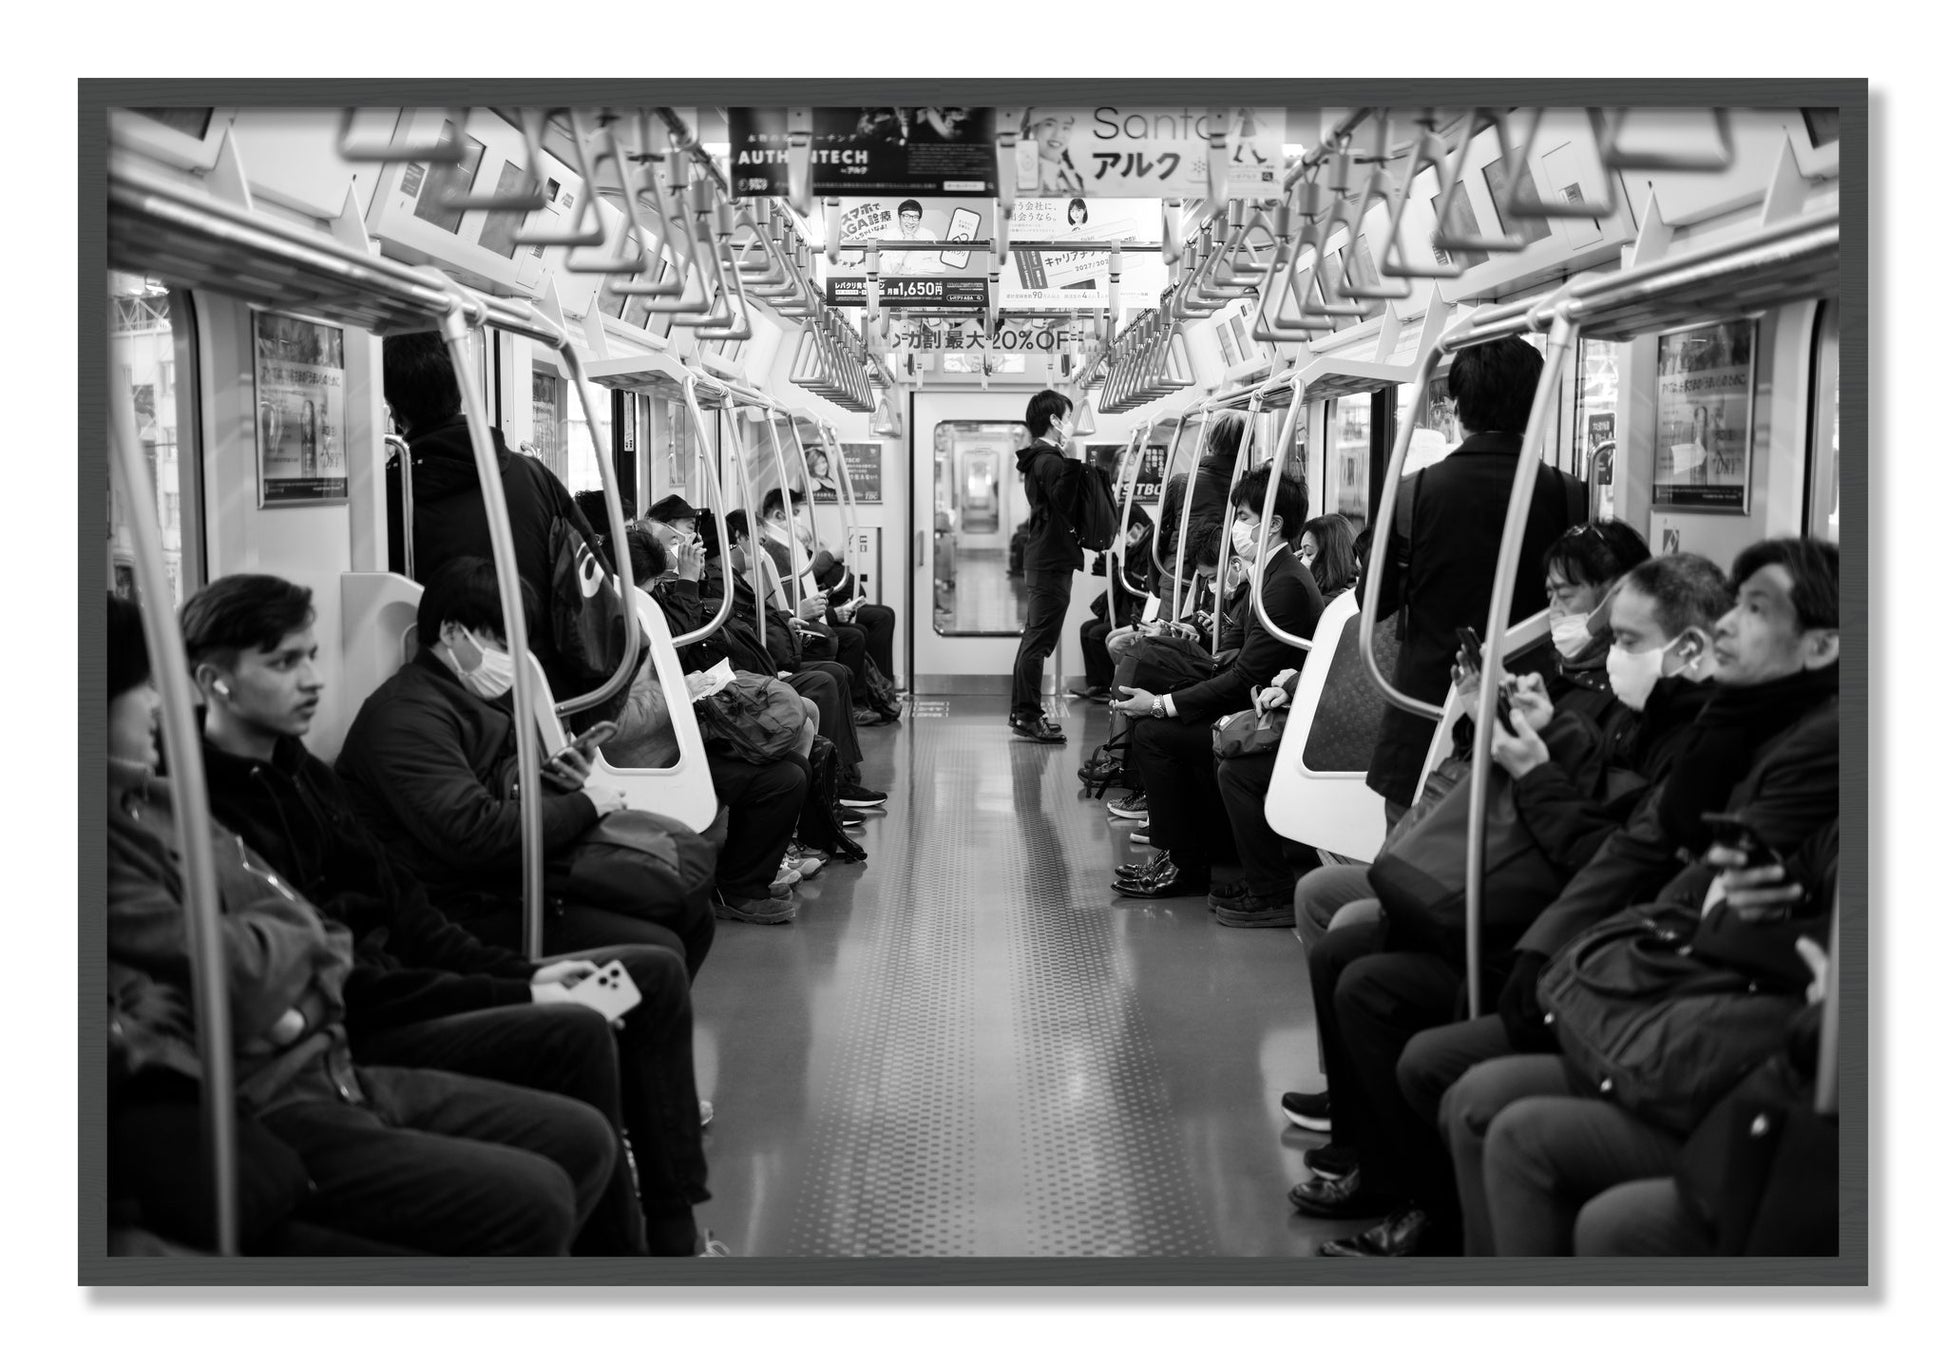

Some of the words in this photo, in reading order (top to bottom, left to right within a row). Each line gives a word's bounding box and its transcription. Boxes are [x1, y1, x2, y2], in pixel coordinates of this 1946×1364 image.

[738, 149, 869, 165] AUTHTECH
[1092, 152, 1181, 180] アルク
[1075, 257, 1109, 272] 2027/202
